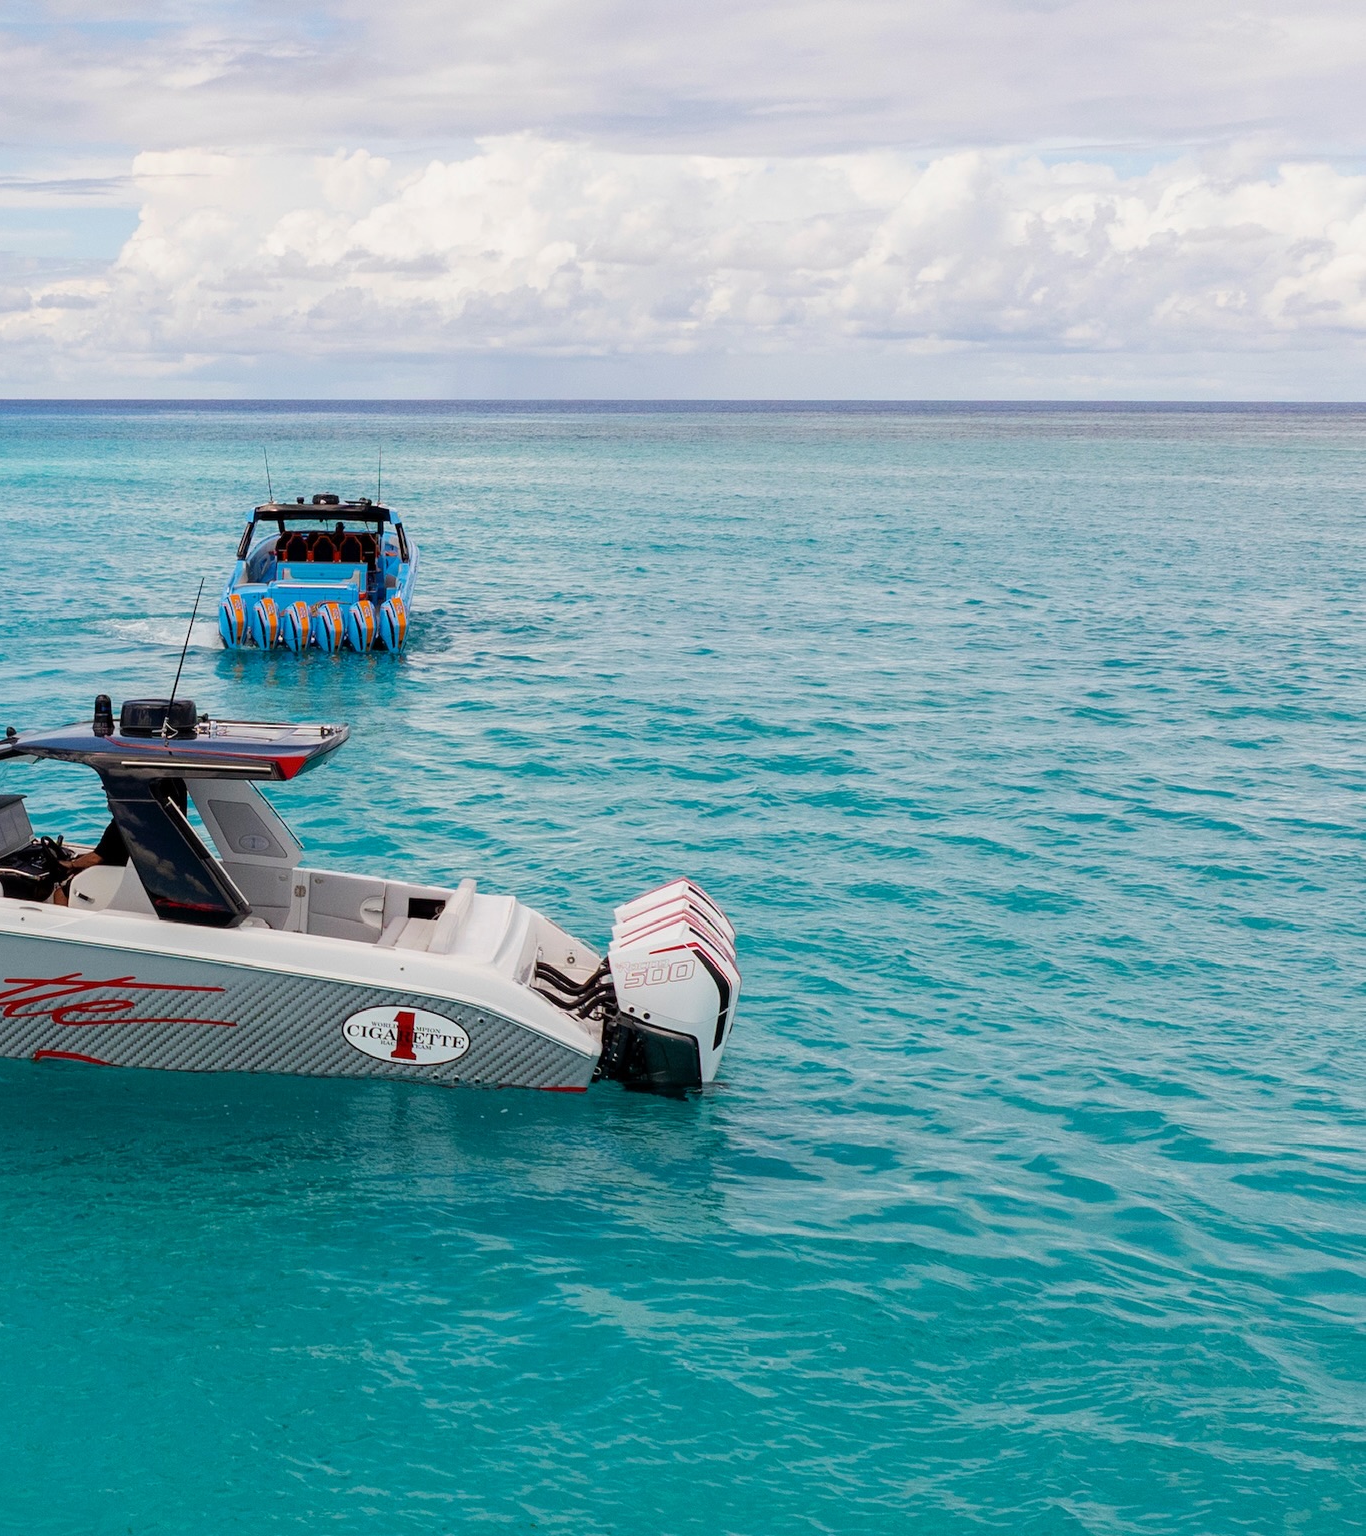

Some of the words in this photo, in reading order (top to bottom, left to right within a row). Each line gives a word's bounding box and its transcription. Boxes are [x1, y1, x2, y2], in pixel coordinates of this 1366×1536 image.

[624, 959, 696, 989] 500
[347, 1024, 465, 1049] CIGARETTE
[390, 1011, 417, 1060] 1
[402, 1024, 441, 1034] MPION
